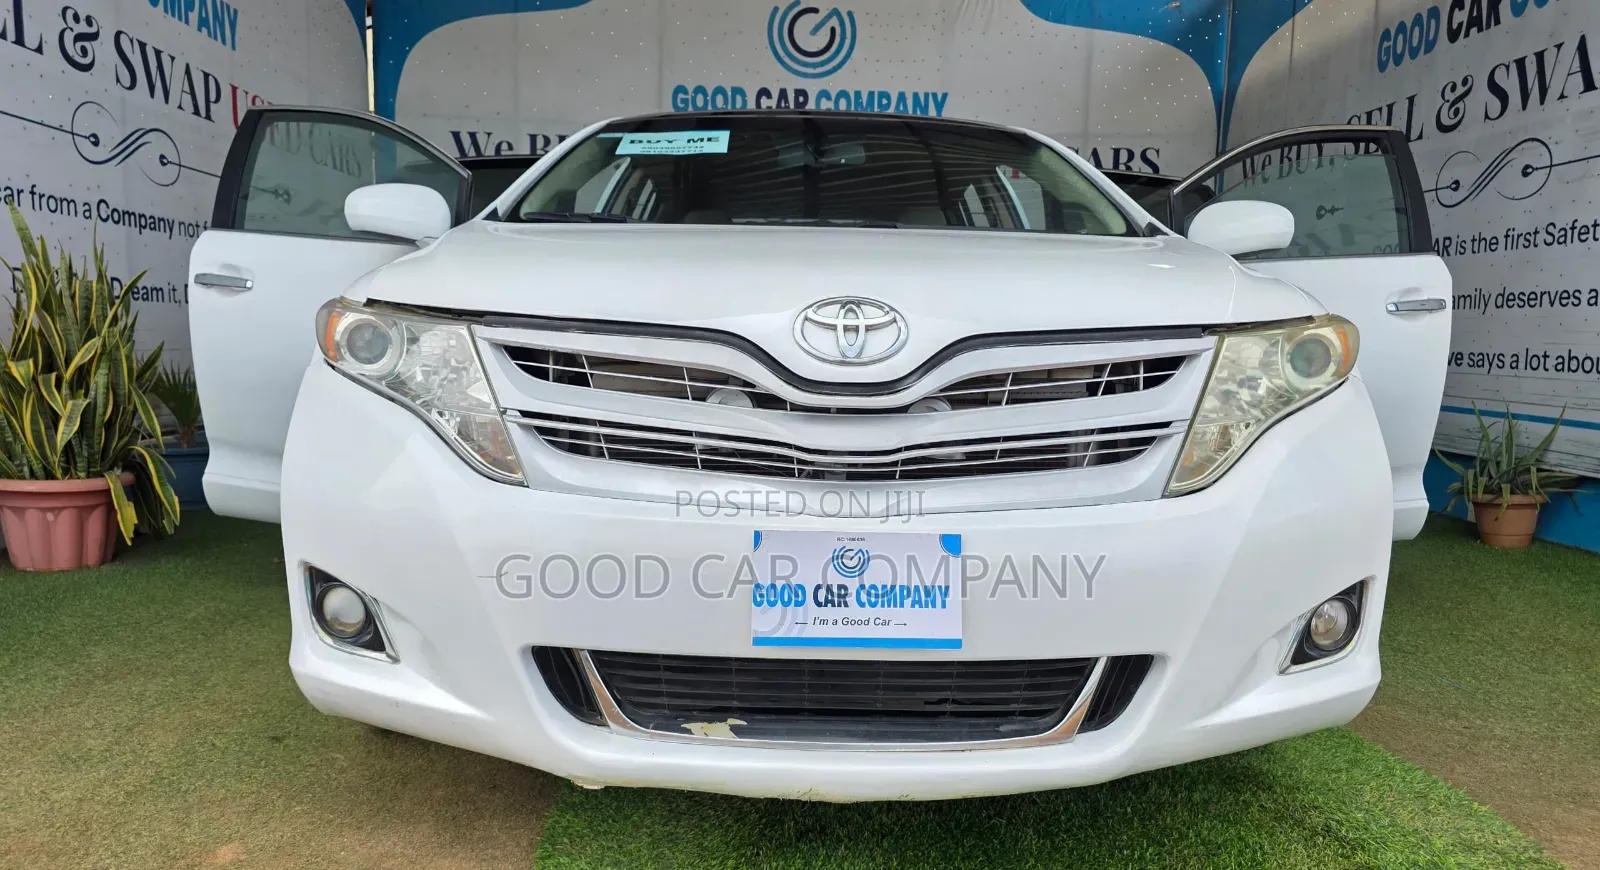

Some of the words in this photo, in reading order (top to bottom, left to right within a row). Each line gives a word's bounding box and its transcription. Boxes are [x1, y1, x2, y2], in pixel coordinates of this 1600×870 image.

[147, 0, 239, 52] PANY
[1377, 5, 1441, 73] GOOD
[1446, 0, 1501, 44] CAR
[59, 6, 99, 73] &
[113, 30, 222, 124] SWAP
[671, 84, 748, 112] GOOD
[754, 87, 810, 110] CAR
[815, 88, 949, 118] COMPANY
[1241, 152, 1272, 189] We
[1435, 74, 1474, 134] &
[1483, 33, 1599, 123] SWA
[450, 130, 514, 158] We
[29, 184, 78, 218] from
[82, 201, 92, 220] a
[96, 199, 175, 240] Company
[178, 222, 201, 238] not
[1455, 234, 1467, 256] is
[1471, 232, 1499, 254] the
[1504, 226, 1540, 251] first
[1543, 218, 1600, 247] Safet
[110, 276, 164, 304] Deam
[168, 282, 182, 308] it,
[1494, 286, 1582, 309] deserves
[1587, 288, 1599, 307] a
[1467, 352, 1505, 375] says
[1510, 353, 1519, 370] a
[1524, 347, 1550, 371] lot
[752, 583, 807, 608] GOOD
[812, 583, 849, 608] CAR
[855, 584, 950, 609] COMPANY
[812, 616, 829, 626] I'm
[841, 617, 870, 627] Good
[873, 617, 892, 627] Car
